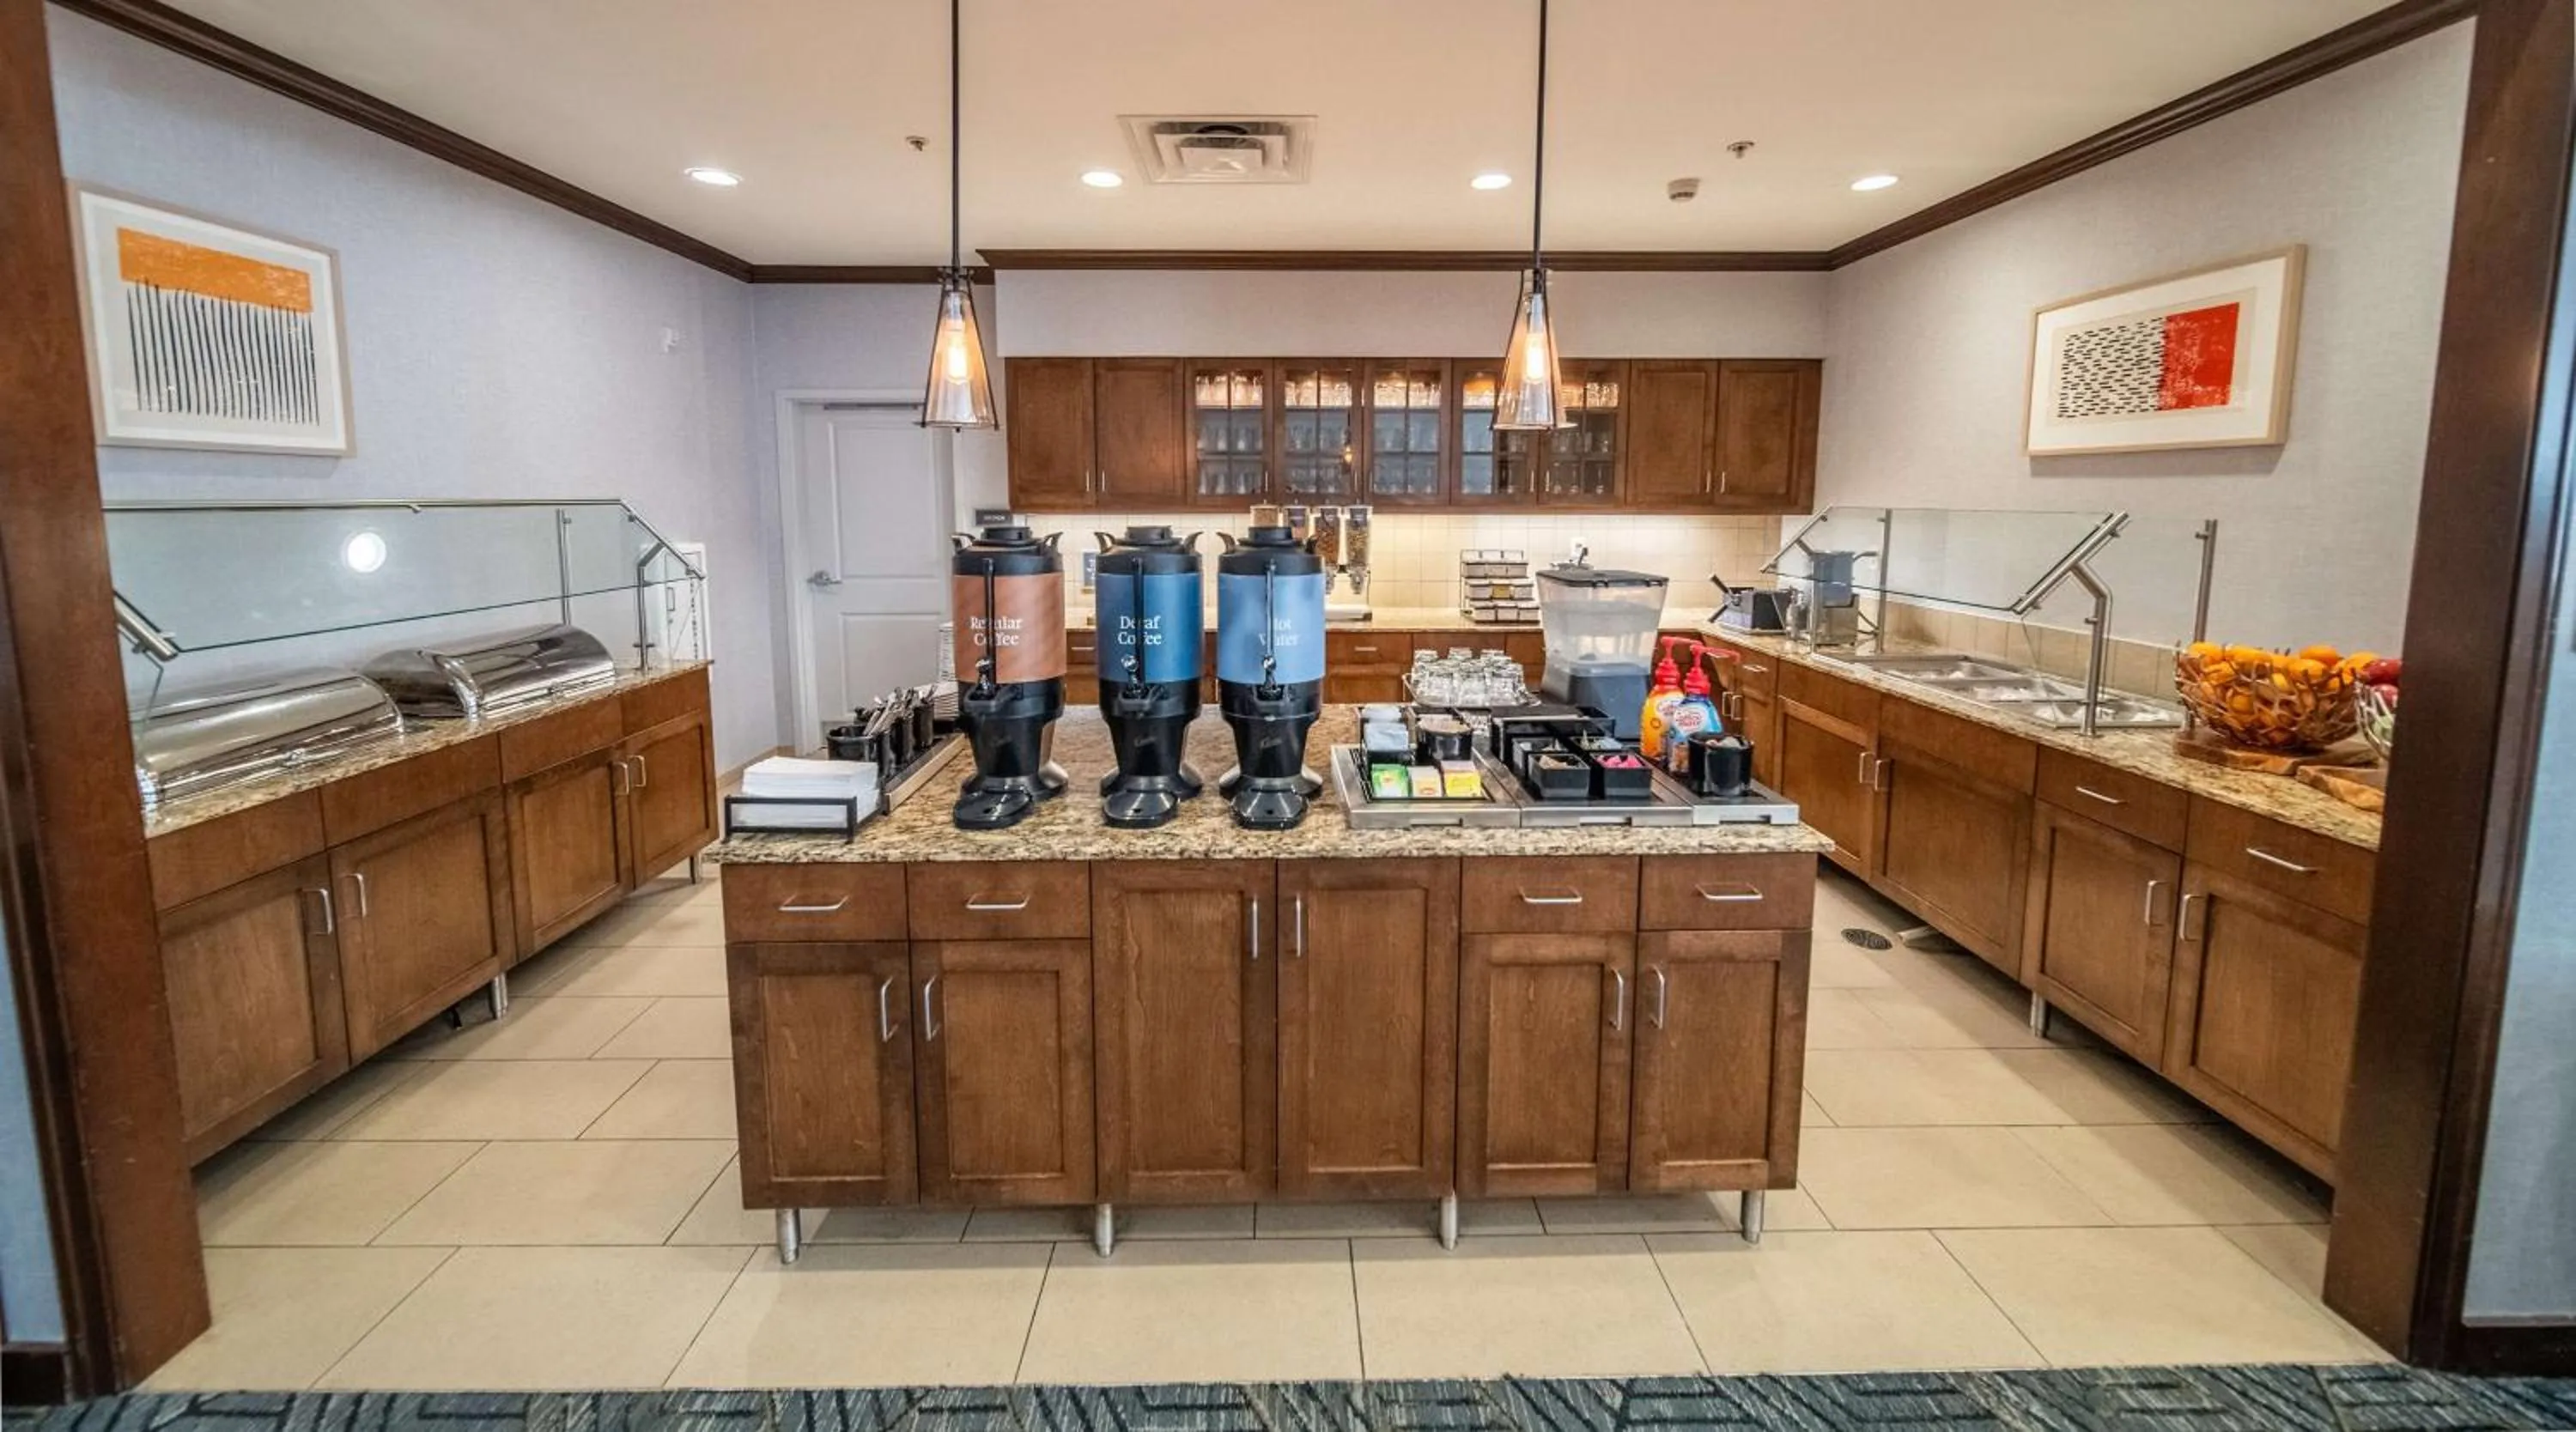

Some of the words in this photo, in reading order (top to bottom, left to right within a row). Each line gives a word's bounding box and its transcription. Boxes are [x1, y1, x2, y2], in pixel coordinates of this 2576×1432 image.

[970, 616, 1023, 631] Reular
[1120, 615, 1161, 629] Deaf
[974, 633, 1019, 646] Cfee
[1118, 631, 1162, 645] Coee
